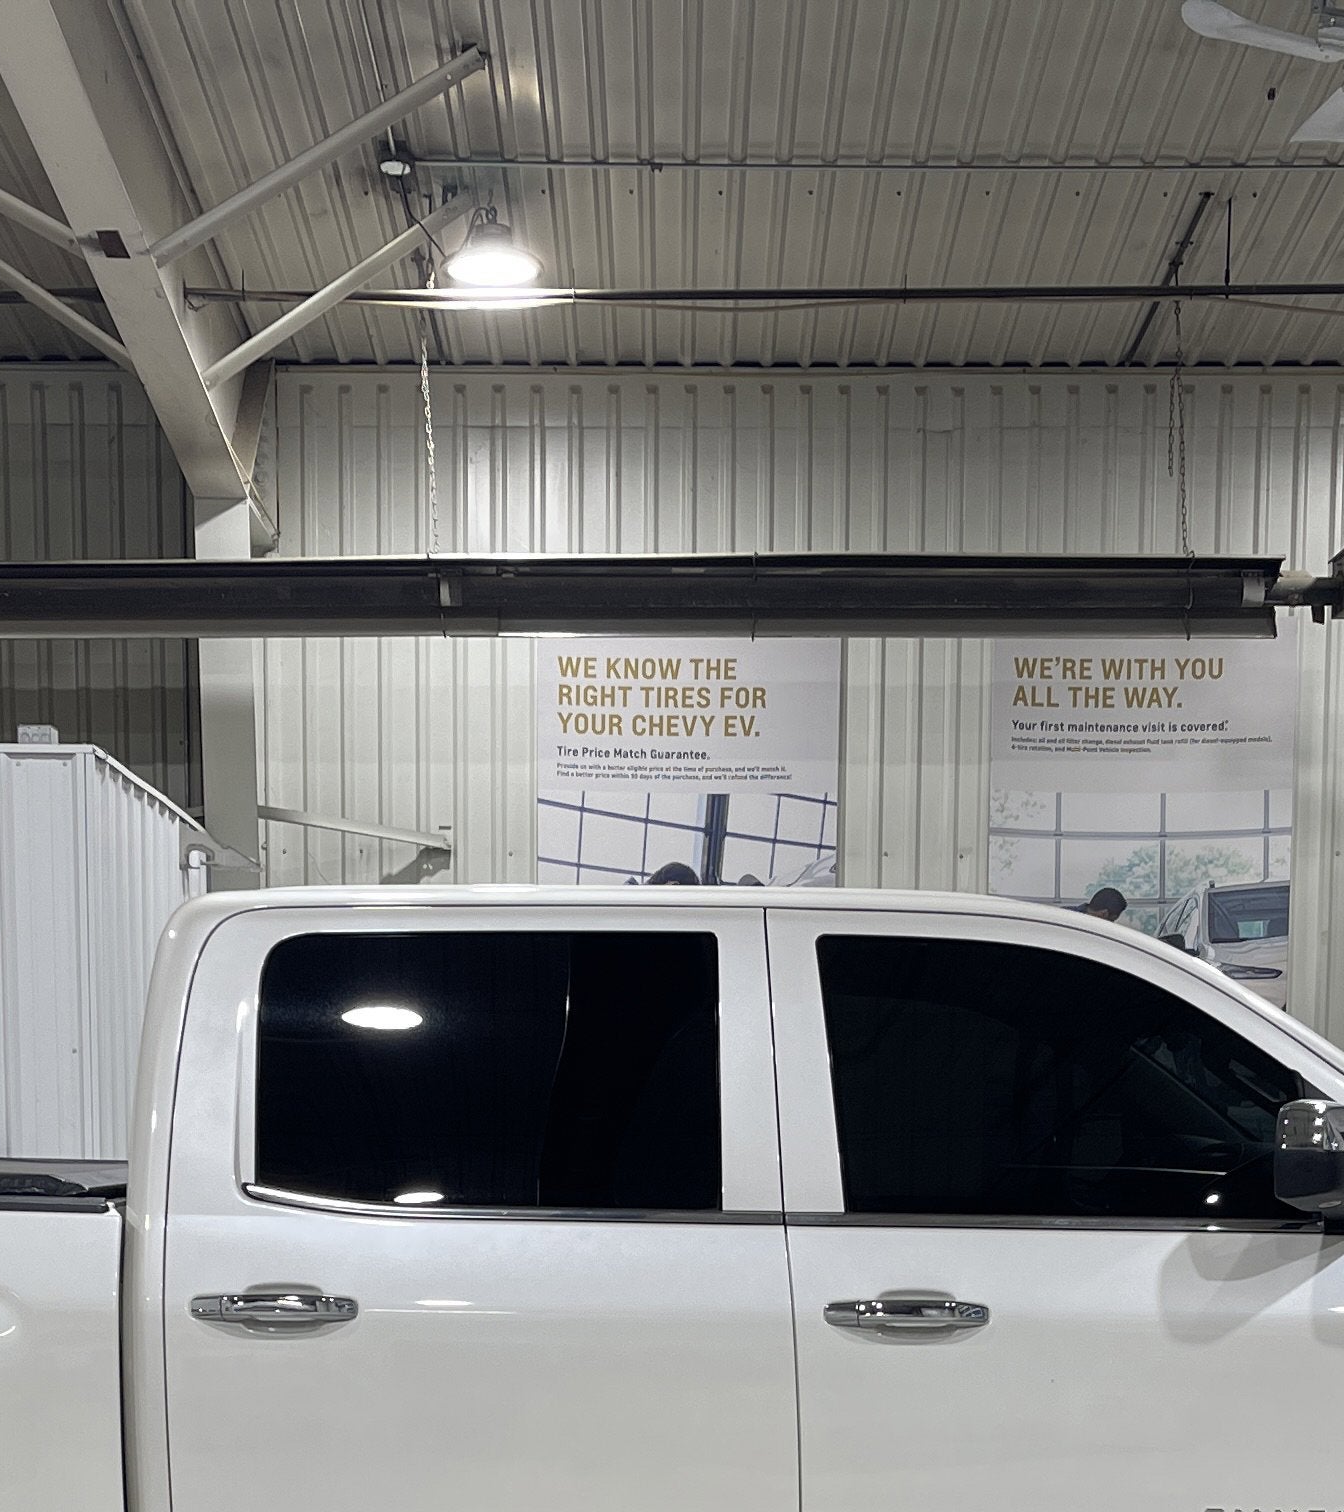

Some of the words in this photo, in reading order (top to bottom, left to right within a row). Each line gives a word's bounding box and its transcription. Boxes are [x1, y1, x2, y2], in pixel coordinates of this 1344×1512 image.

[557, 656, 597, 678] WE
[606, 657, 682, 680] KNOW
[689, 658, 738, 680] THE
[1014, 656, 1093, 680] WE'RE
[1101, 658, 1166, 680] WITH
[1174, 657, 1224, 680] YOU
[558, 684, 632, 707] RIGHT
[640, 686, 711, 708] TIRES
[719, 687, 767, 709] FOR
[1012, 685, 1060, 708] ALL
[1067, 686, 1115, 708] THE
[1123, 686, 1184, 709] WAY.
[557, 712, 623, 735] YOUR
[632, 714, 716, 737] CHEVY
[724, 715, 761, 737] EV.
[1012, 720, 1037, 731] Your
[1040, 720, 1065, 732] first
[1067, 721, 1139, 733] maintenance
[1142, 721, 1165, 732] visit
[1168, 721, 1177, 732] is
[557, 746, 578, 757] Tire
[582, 747, 610, 758] Price
[614, 748, 647, 759] Match
